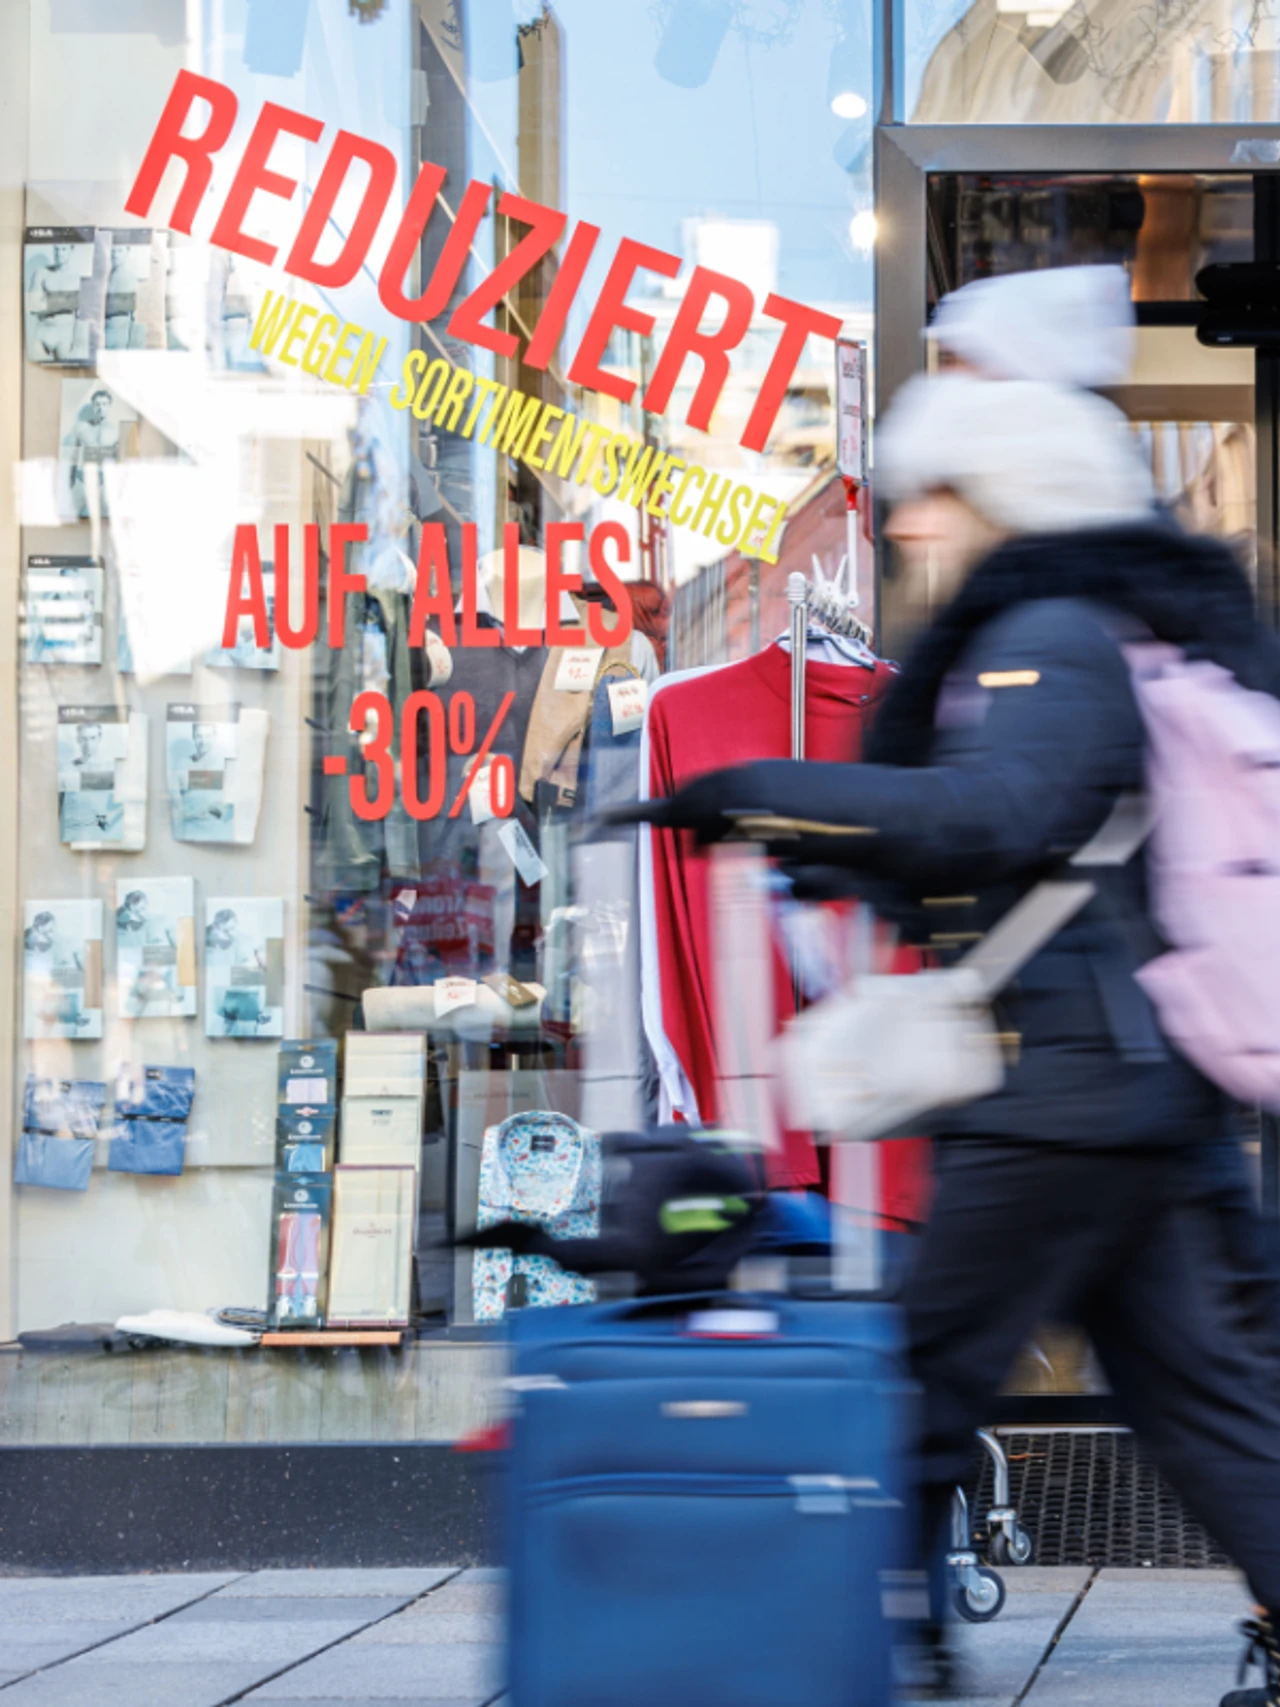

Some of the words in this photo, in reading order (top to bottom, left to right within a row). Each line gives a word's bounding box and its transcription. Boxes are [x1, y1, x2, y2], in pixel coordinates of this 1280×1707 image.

[125, 69, 843, 453] REDUZIERT
[249, 290, 388, 395] WEGEN
[389, 349, 789, 564] SORTIMENTSWECHSEL
[222, 523, 367, 649] AUF
[408, 523, 633, 648] ALLES
[323, 690, 515, 820] -30%
